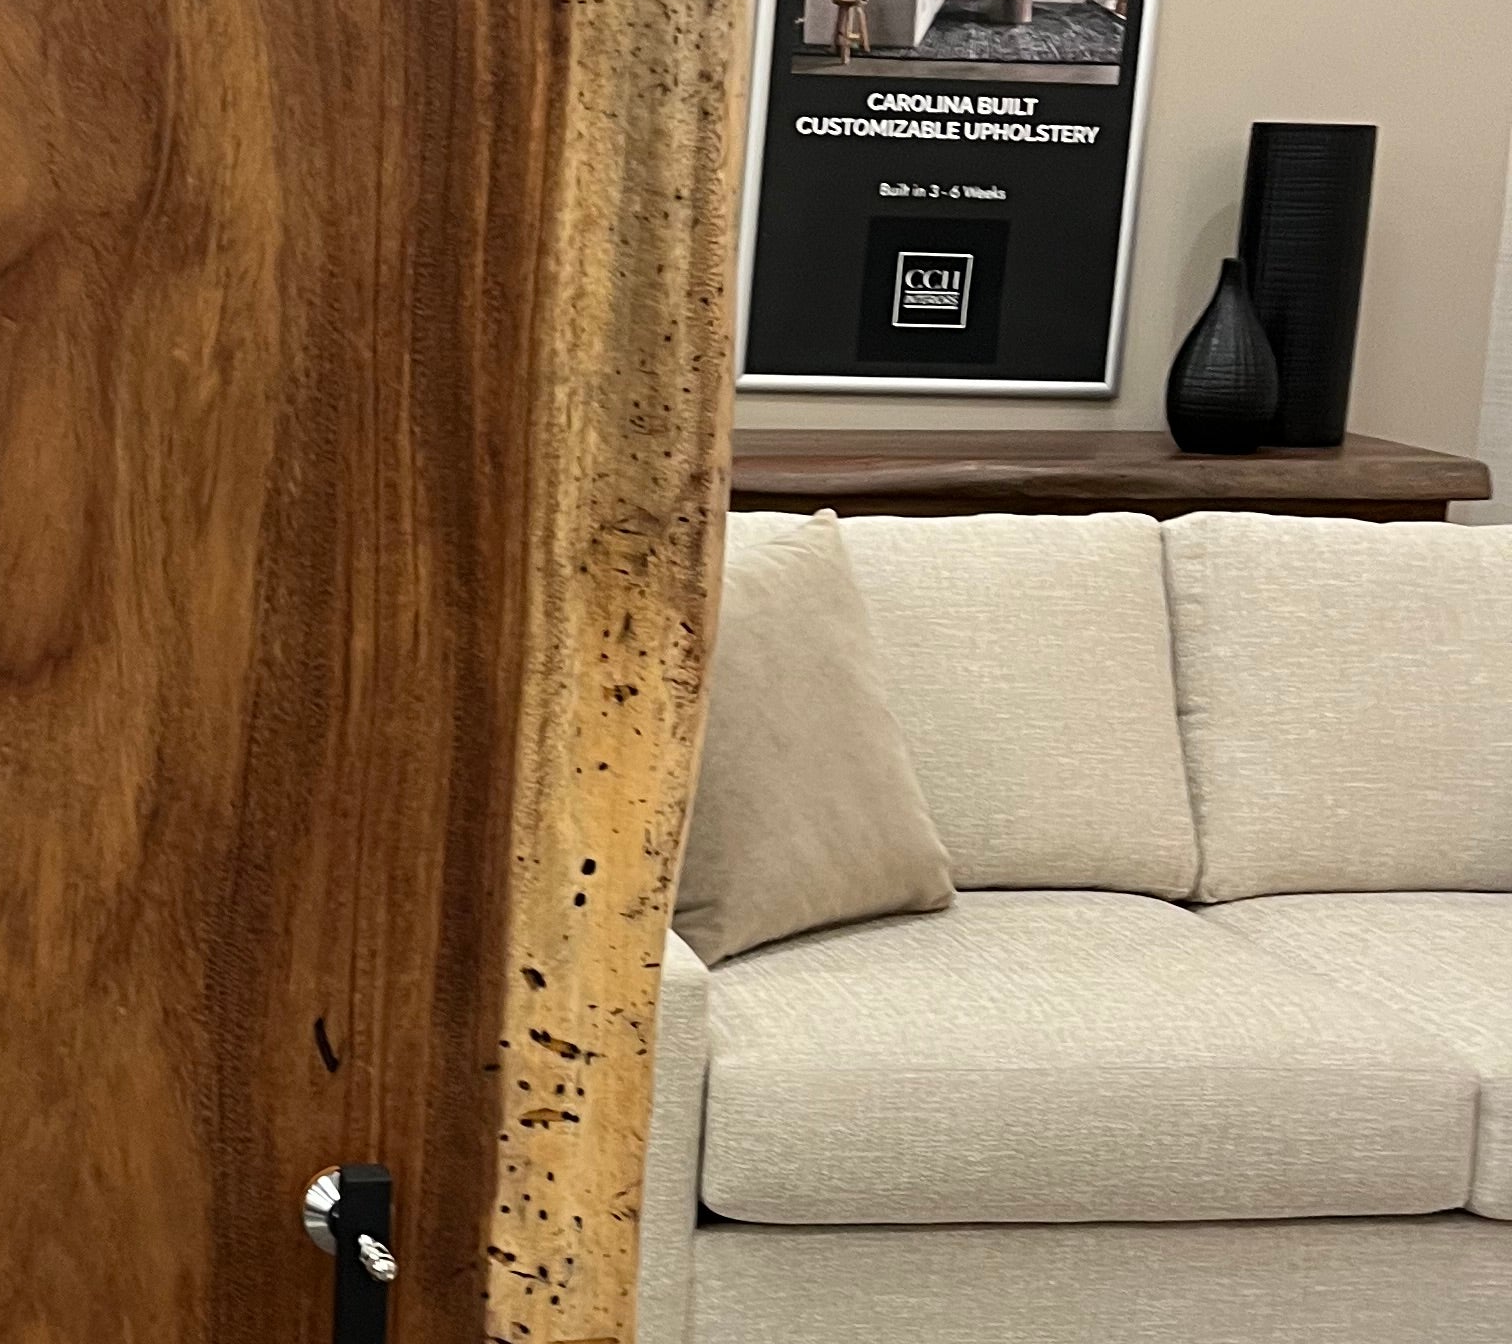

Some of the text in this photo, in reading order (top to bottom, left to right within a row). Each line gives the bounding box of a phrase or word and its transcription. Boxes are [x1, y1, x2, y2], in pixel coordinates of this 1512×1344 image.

[867, 93, 1039, 116] CAROLINA BUILT
[795, 117, 1100, 144] CUSTOMIZABLE UPHOLSTERY
[879, 182, 910, 198] Built
[912, 184, 926, 198] in
[962, 185, 1007, 201] Weeks
[904, 269, 961, 290] CCH
